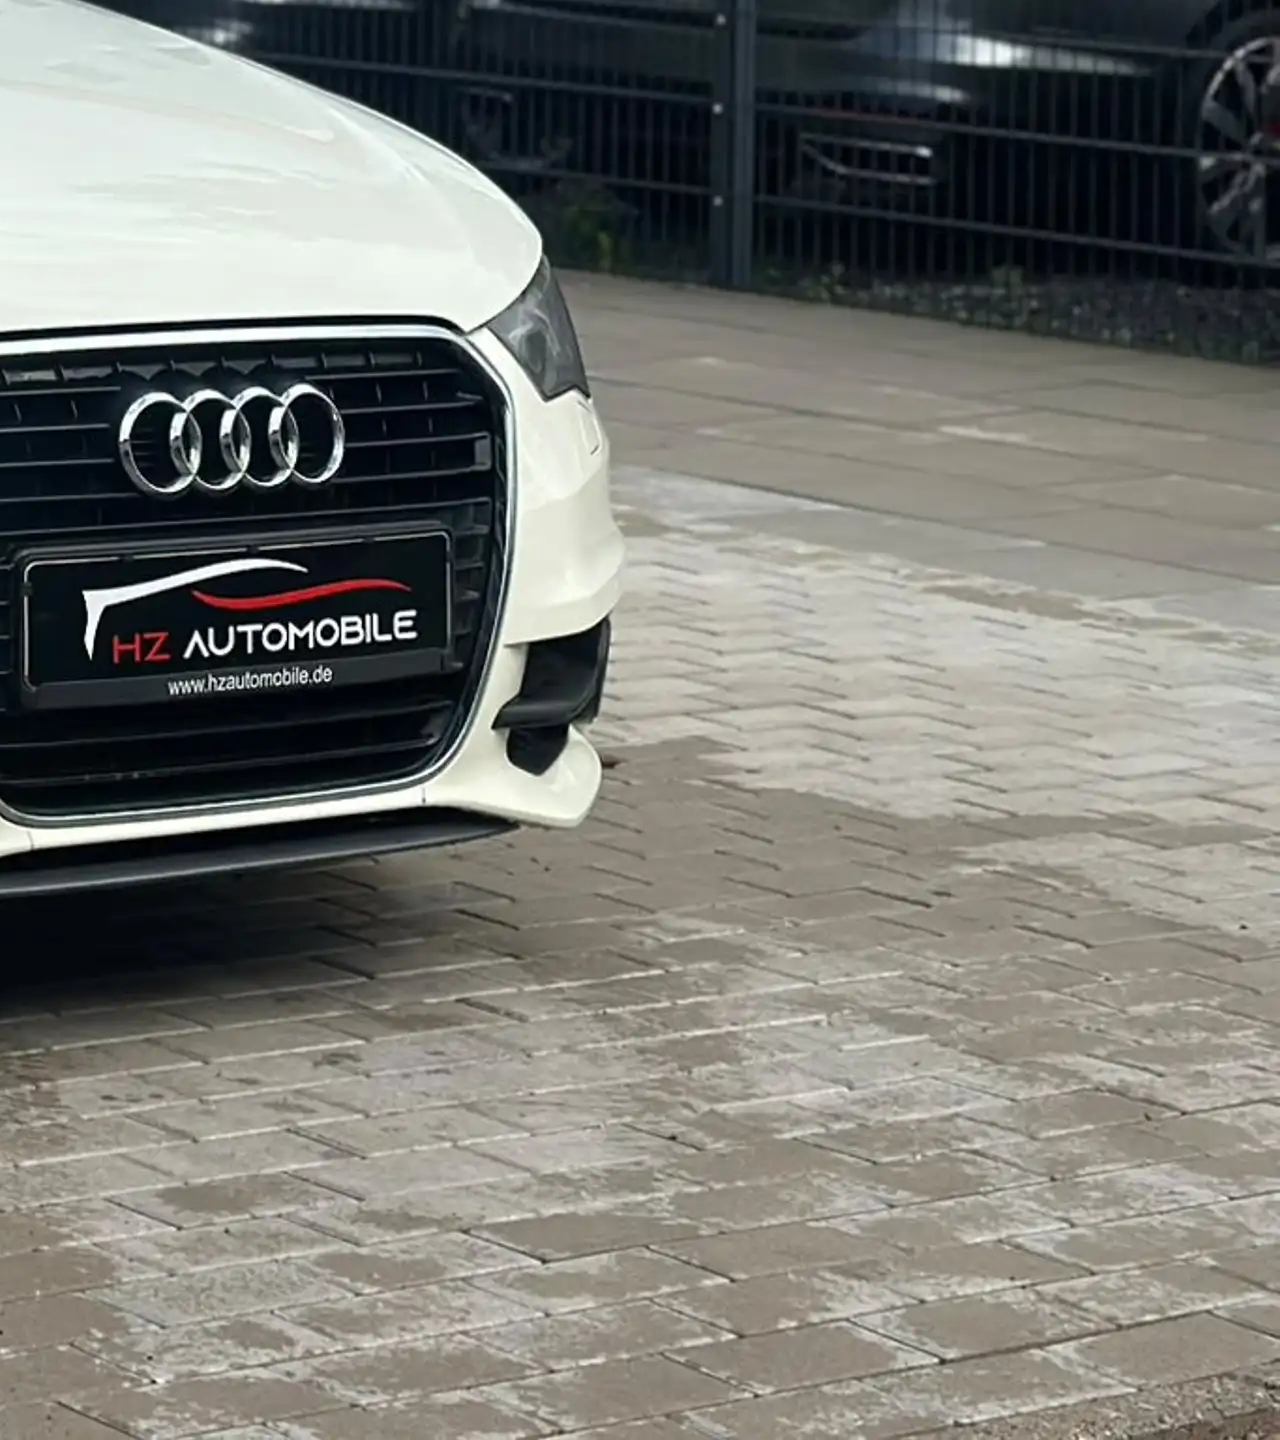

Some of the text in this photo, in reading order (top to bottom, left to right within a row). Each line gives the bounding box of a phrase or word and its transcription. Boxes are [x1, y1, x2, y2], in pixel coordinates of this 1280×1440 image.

[112, 608, 418, 663] HZ AUTOMOBILE
[168, 665, 333, 696] www.hzautomobile.de
